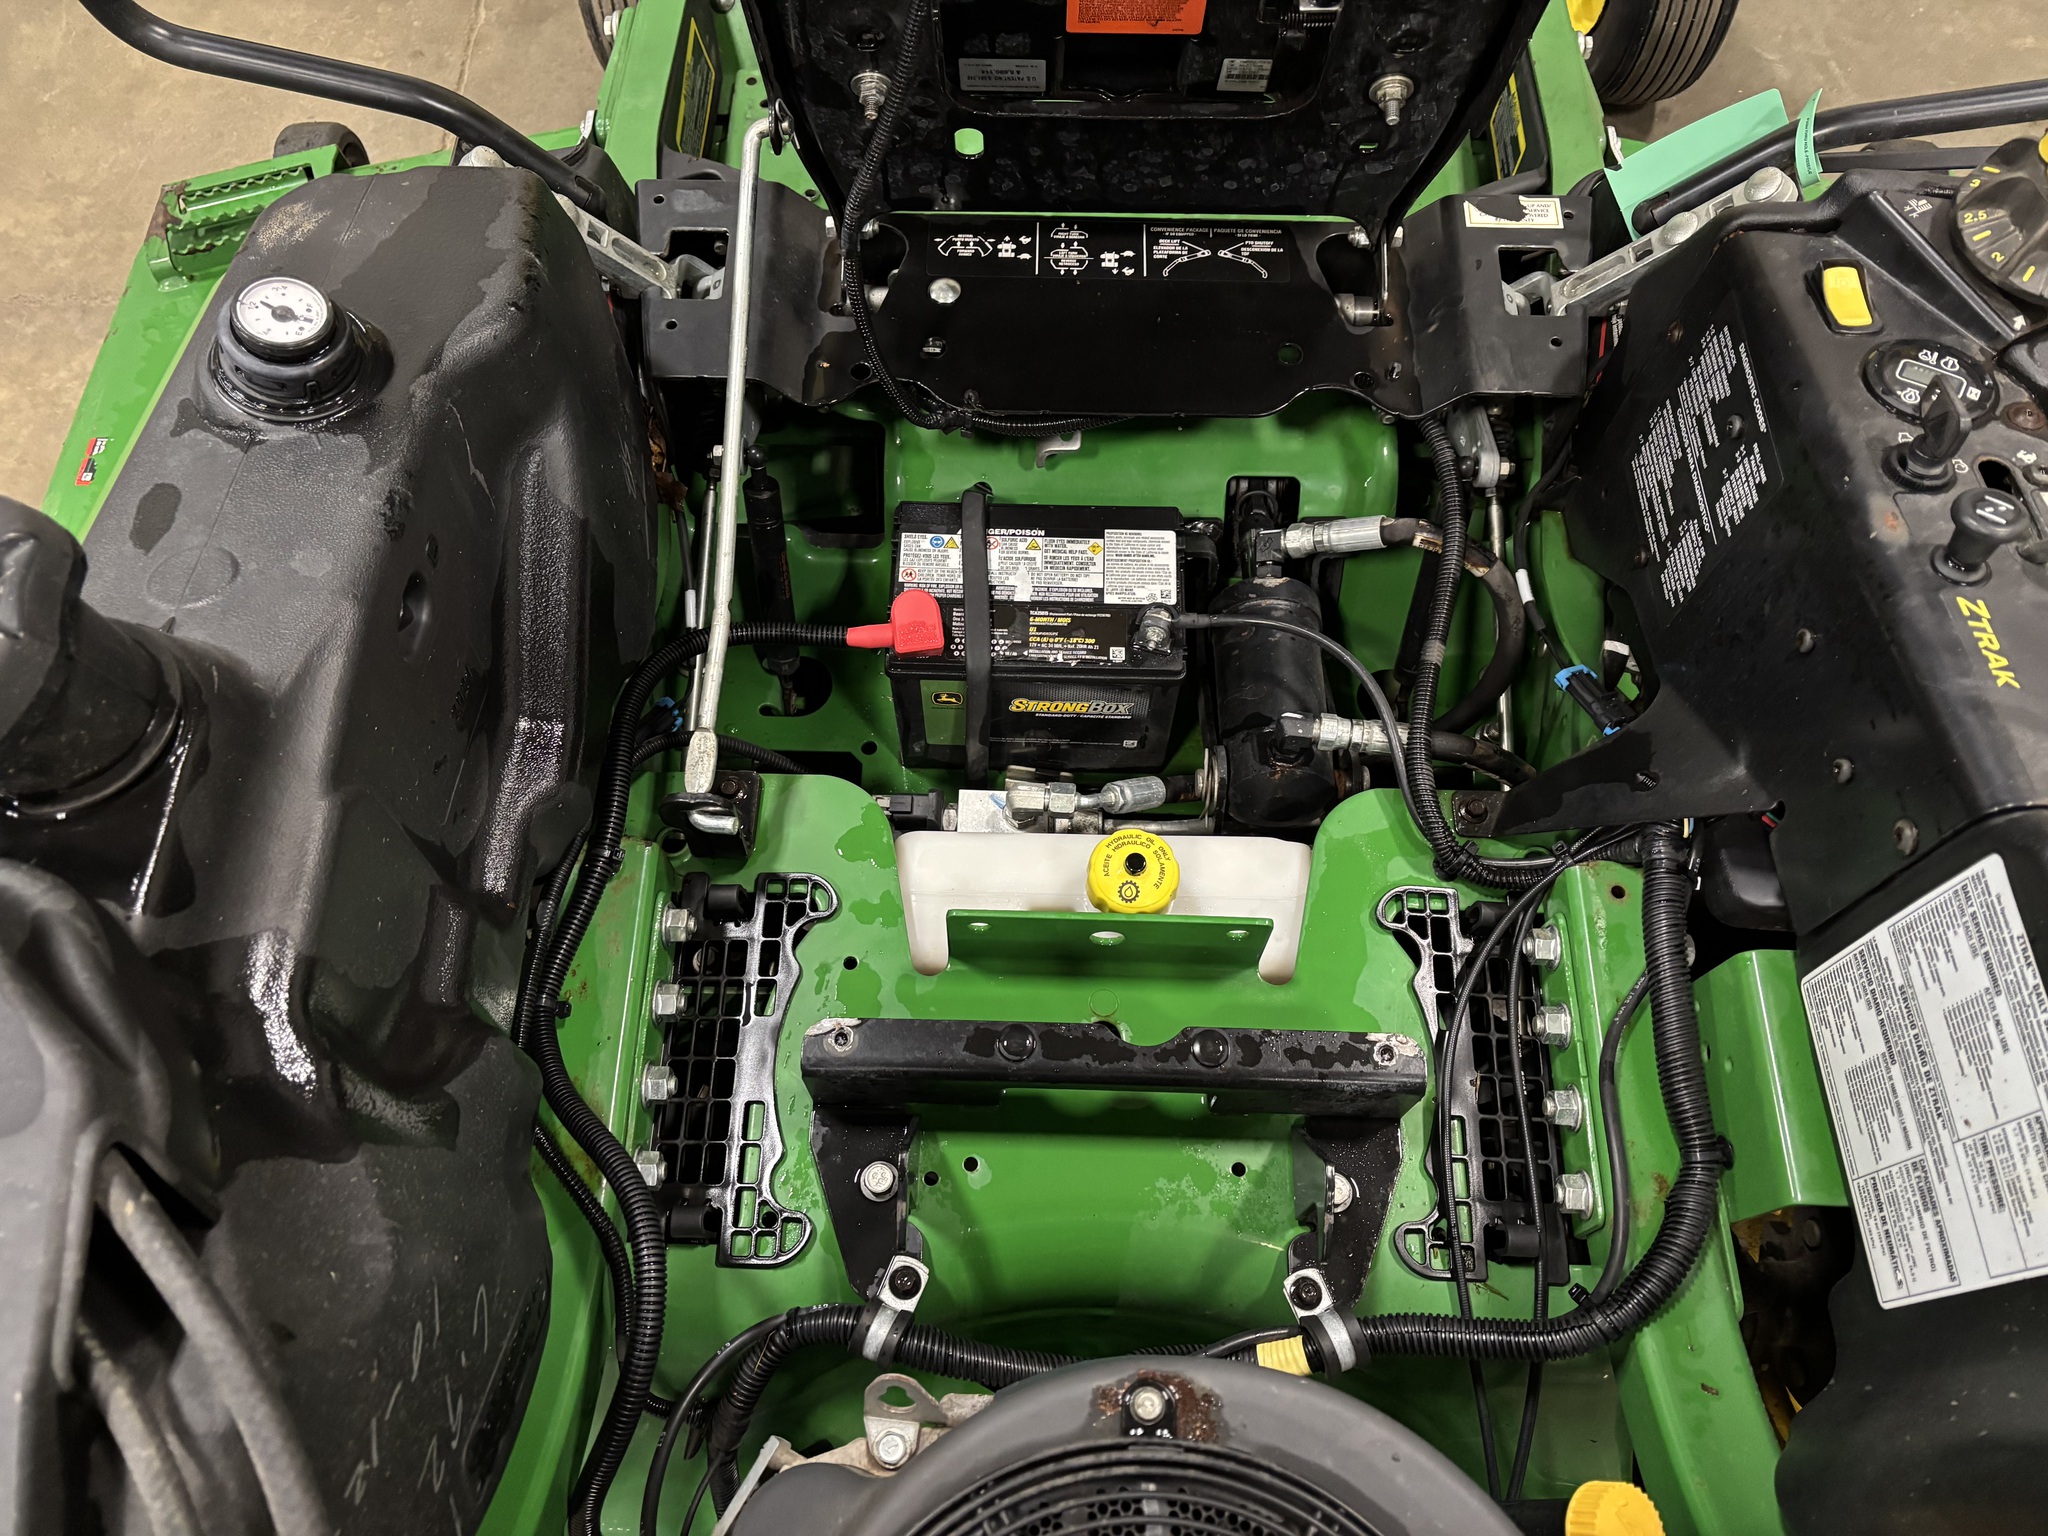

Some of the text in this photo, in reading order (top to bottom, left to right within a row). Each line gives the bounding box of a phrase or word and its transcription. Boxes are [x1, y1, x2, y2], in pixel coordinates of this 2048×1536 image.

[1969, 179, 1981, 188] 3
[1964, 209, 1987, 224] 2.5
[1990, 251, 2005, 262] 2
[1718, 330, 1732, 375] VIOLATIONS
[1722, 323, 1737, 368] INTERLOCK
[1738, 341, 1757, 400] DIAGNOSTIC
[1685, 445, 1695, 473] PARA
[1742, 455, 1758, 505] OVER VOLTAGE
[1749, 453, 1760, 485] FAULTS
[1752, 441, 1767, 485] REAL-TIME
[986, 528, 1045, 536] GER/POISON
[1956, 596, 2021, 691] ZTRAK
[1103, 840, 1166, 889] ACEITE HIDRAULICO SOLAMENTE
[1105, 834, 1171, 861] HYDRAULIC OIL ONLY
[1952, 887, 1979, 960] BEFORE EACH USE
[1960, 881, 2002, 998] DAILY SERVICE REQUIRED
[1852, 952, 1861, 972] ANTES
[1857, 971, 1863, 981] DE
[1860, 980, 1868, 998] CADA
[1857, 947, 1897, 1066] SERVICIO DIARIO REQUERIDO
[1983, 985, 2010, 1055] AFTER EACH USE
[2031, 982, 2048, 1015] DAILY
[1897, 983, 1916, 1031] SERVICIO
[1912, 1032, 1928, 1068] DIARIO
[1923, 1069, 1933, 1085] DE
[1887, 1074, 1894, 1082] DE
[1889, 1081, 1899, 1100] HABER
[1894, 1099, 1904, 1118] USADO
[1898, 1117, 1906, 1125] LA
[2024, 1117, 2047, 1173] (WITH FILTER
[1910, 1160, 1930, 1213] DE FLUIDOS
[1978, 1135, 2007, 1213] TIRE PRESSURE:
[1869, 1175, 1905, 1289] PRESIÓN DE NEUMÁTICS:
[1902, 1163, 1937, 1272] (INCLUYE CAMBIO DE FILTRO)
[1917, 1157, 1957, 1282] CAPACIDADES APROXIMADAS
